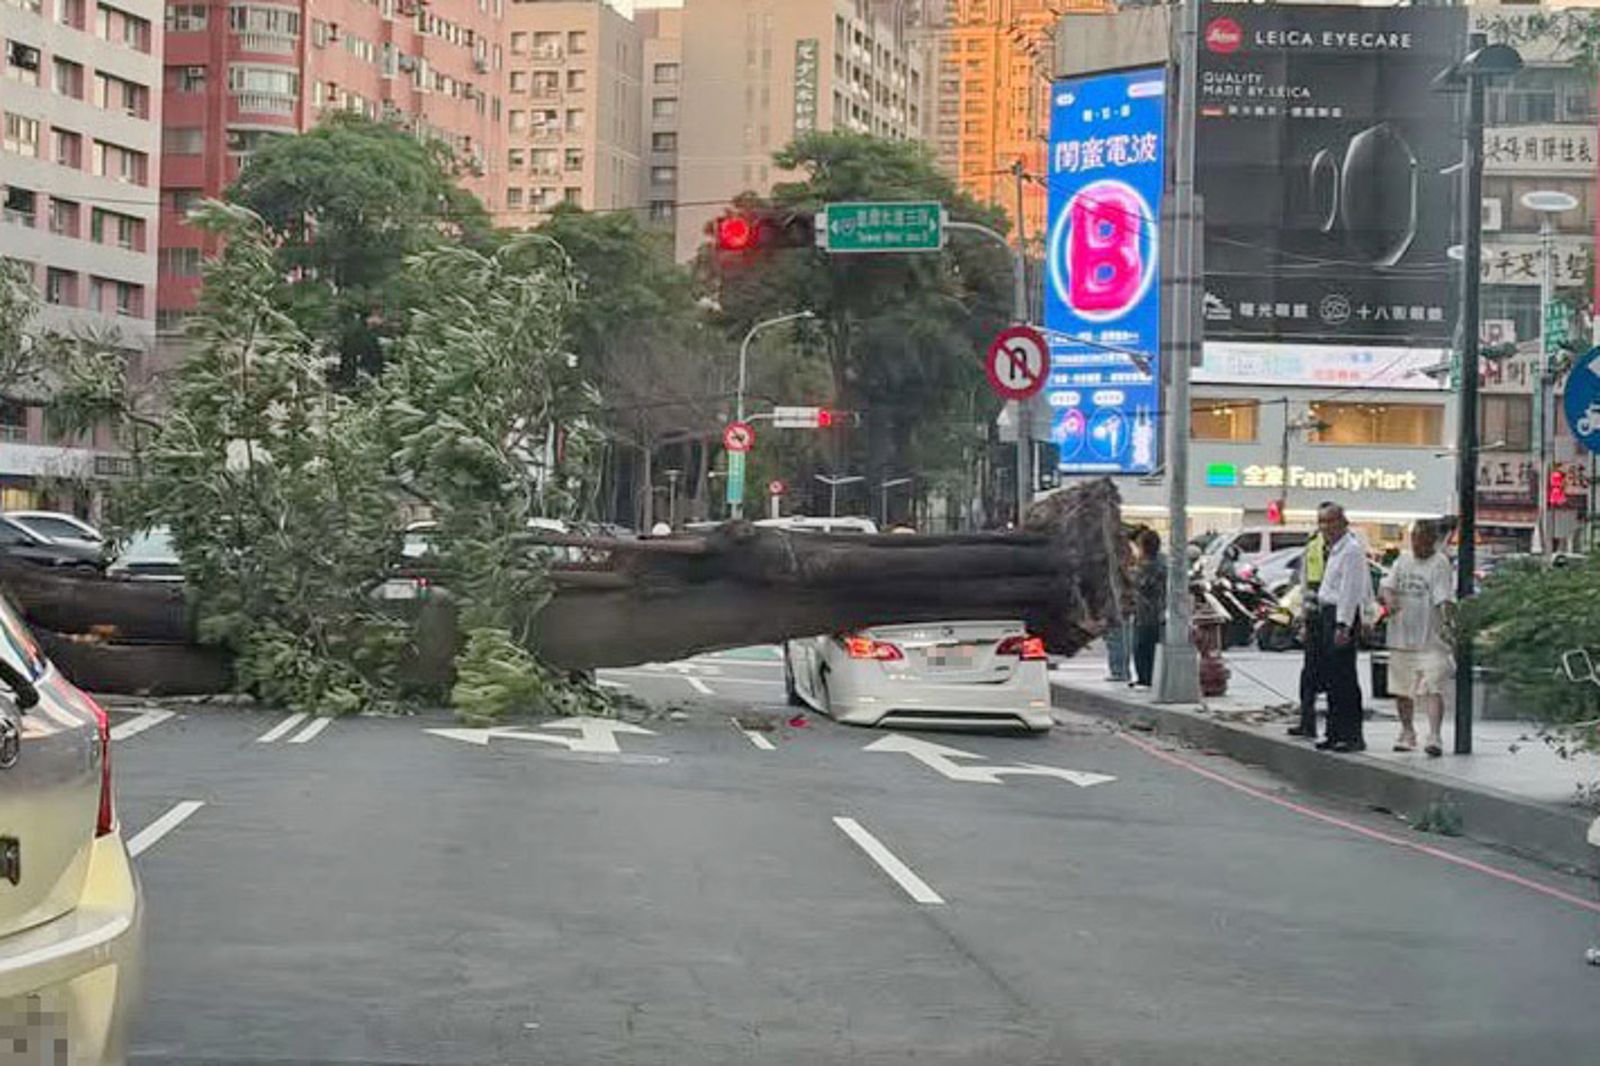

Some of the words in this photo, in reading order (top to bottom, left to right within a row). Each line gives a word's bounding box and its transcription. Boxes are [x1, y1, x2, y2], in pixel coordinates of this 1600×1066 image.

[1254, 30, 1313, 46] LEICA
[1322, 31, 1412, 48] EYECARE
[1203, 72, 1262, 85] QUALITY
[1203, 85, 1241, 97] MADE
[1248, 86, 1264, 98] BY
[1269, 86, 1311, 98] LEICA
[1288, 466, 1417, 491] FamilyMart
